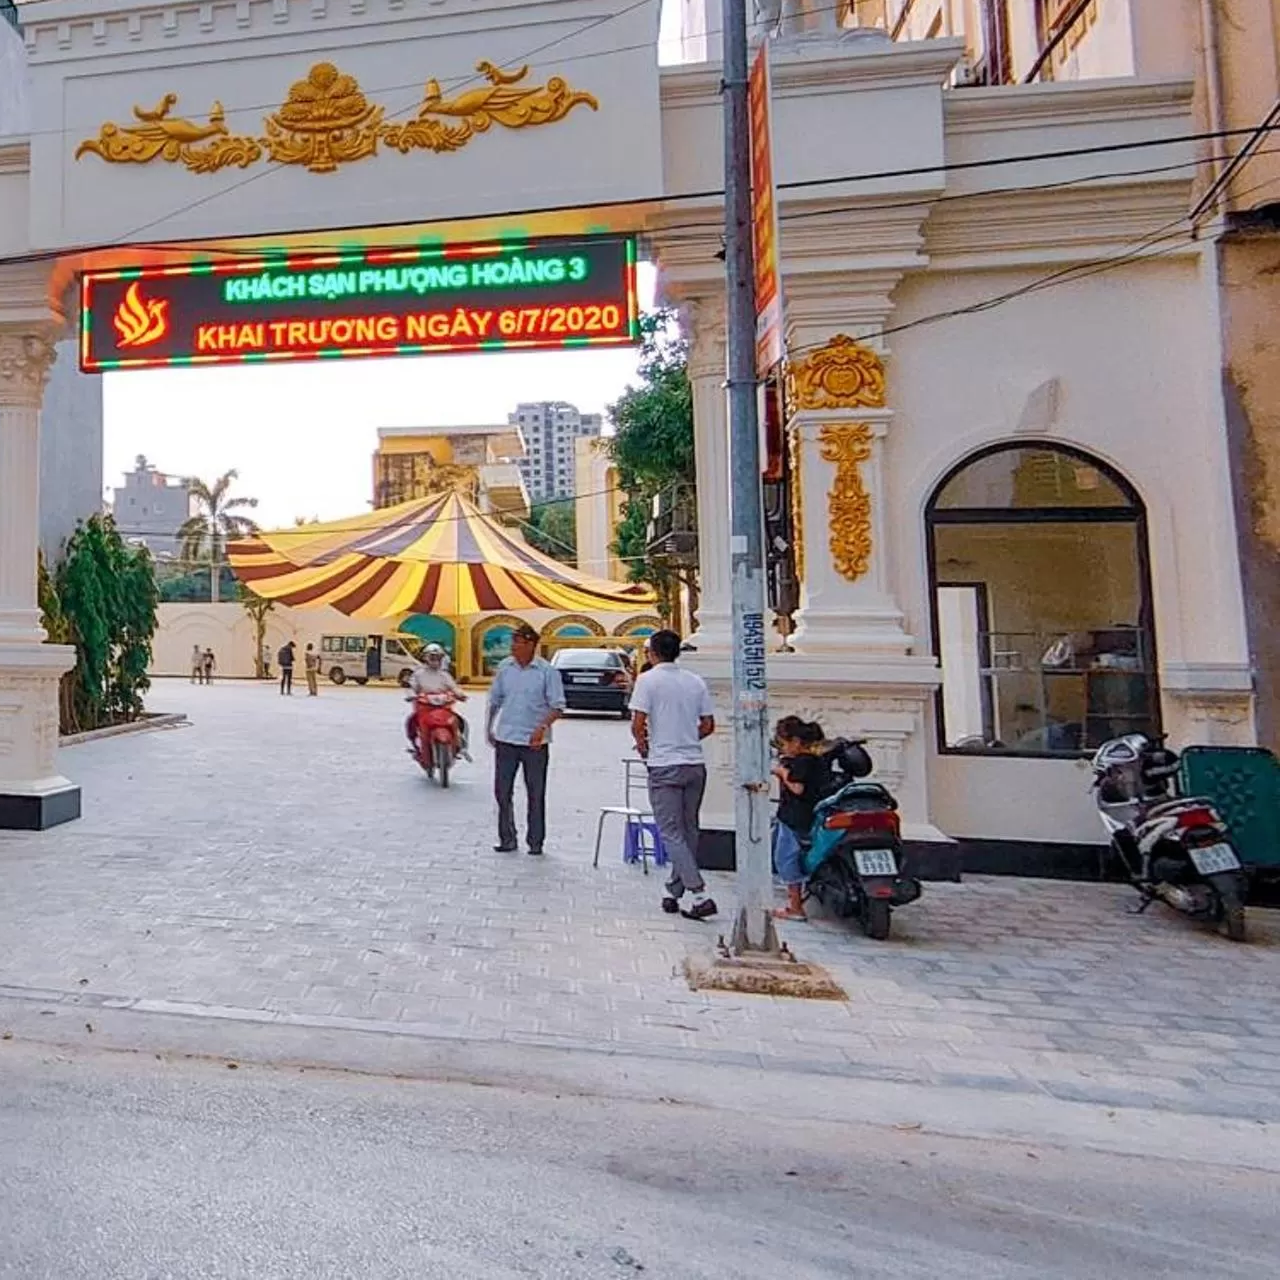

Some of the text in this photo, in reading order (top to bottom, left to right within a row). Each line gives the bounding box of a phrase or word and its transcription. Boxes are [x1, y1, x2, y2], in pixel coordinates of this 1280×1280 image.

[225, 257, 586, 301] KHÁCH SẠN PHƯỢNG HOÀNG 3
[197, 305, 619, 349] KHAI TRƯƠNG NGÀY 6/7/2020
